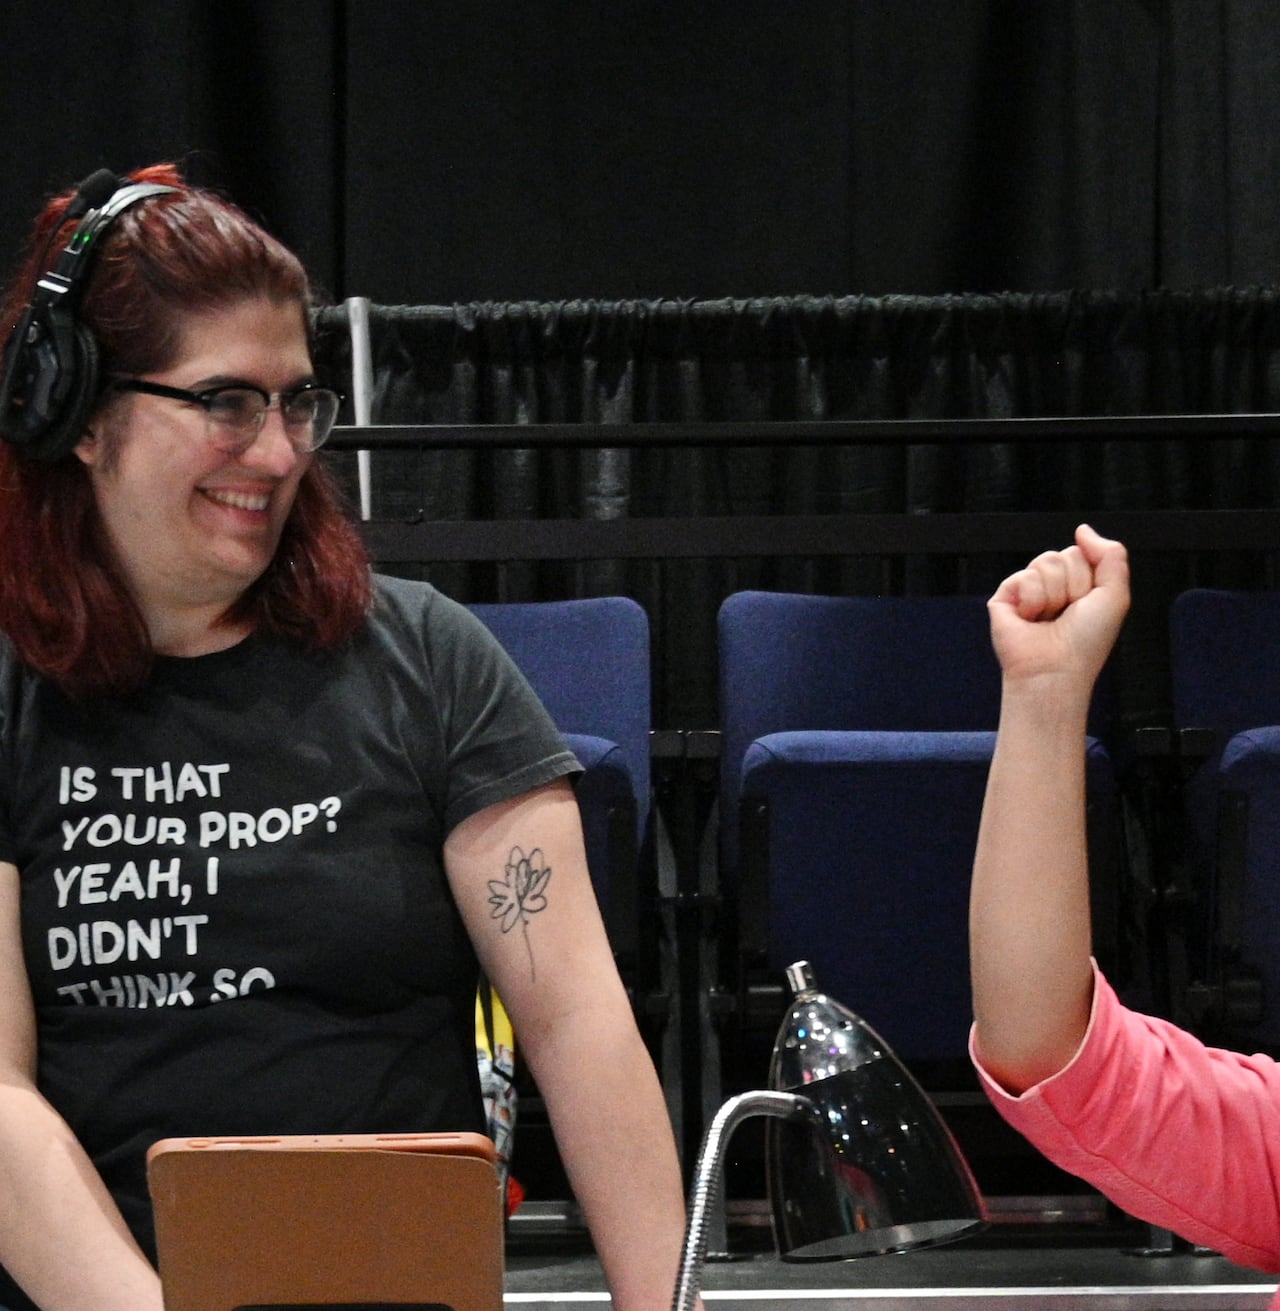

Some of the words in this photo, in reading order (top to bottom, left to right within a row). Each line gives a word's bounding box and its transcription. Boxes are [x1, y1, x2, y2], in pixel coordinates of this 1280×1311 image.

[59, 766, 97, 804] IS
[111, 761, 230, 804] THAT
[61, 813, 187, 851] YOUR
[199, 796, 342, 849] PROP?
[53, 857, 192, 908] YEAH,
[207, 856, 219, 895] I
[48, 914, 208, 970] DIDN'T
[57, 971, 196, 1009] THINK
